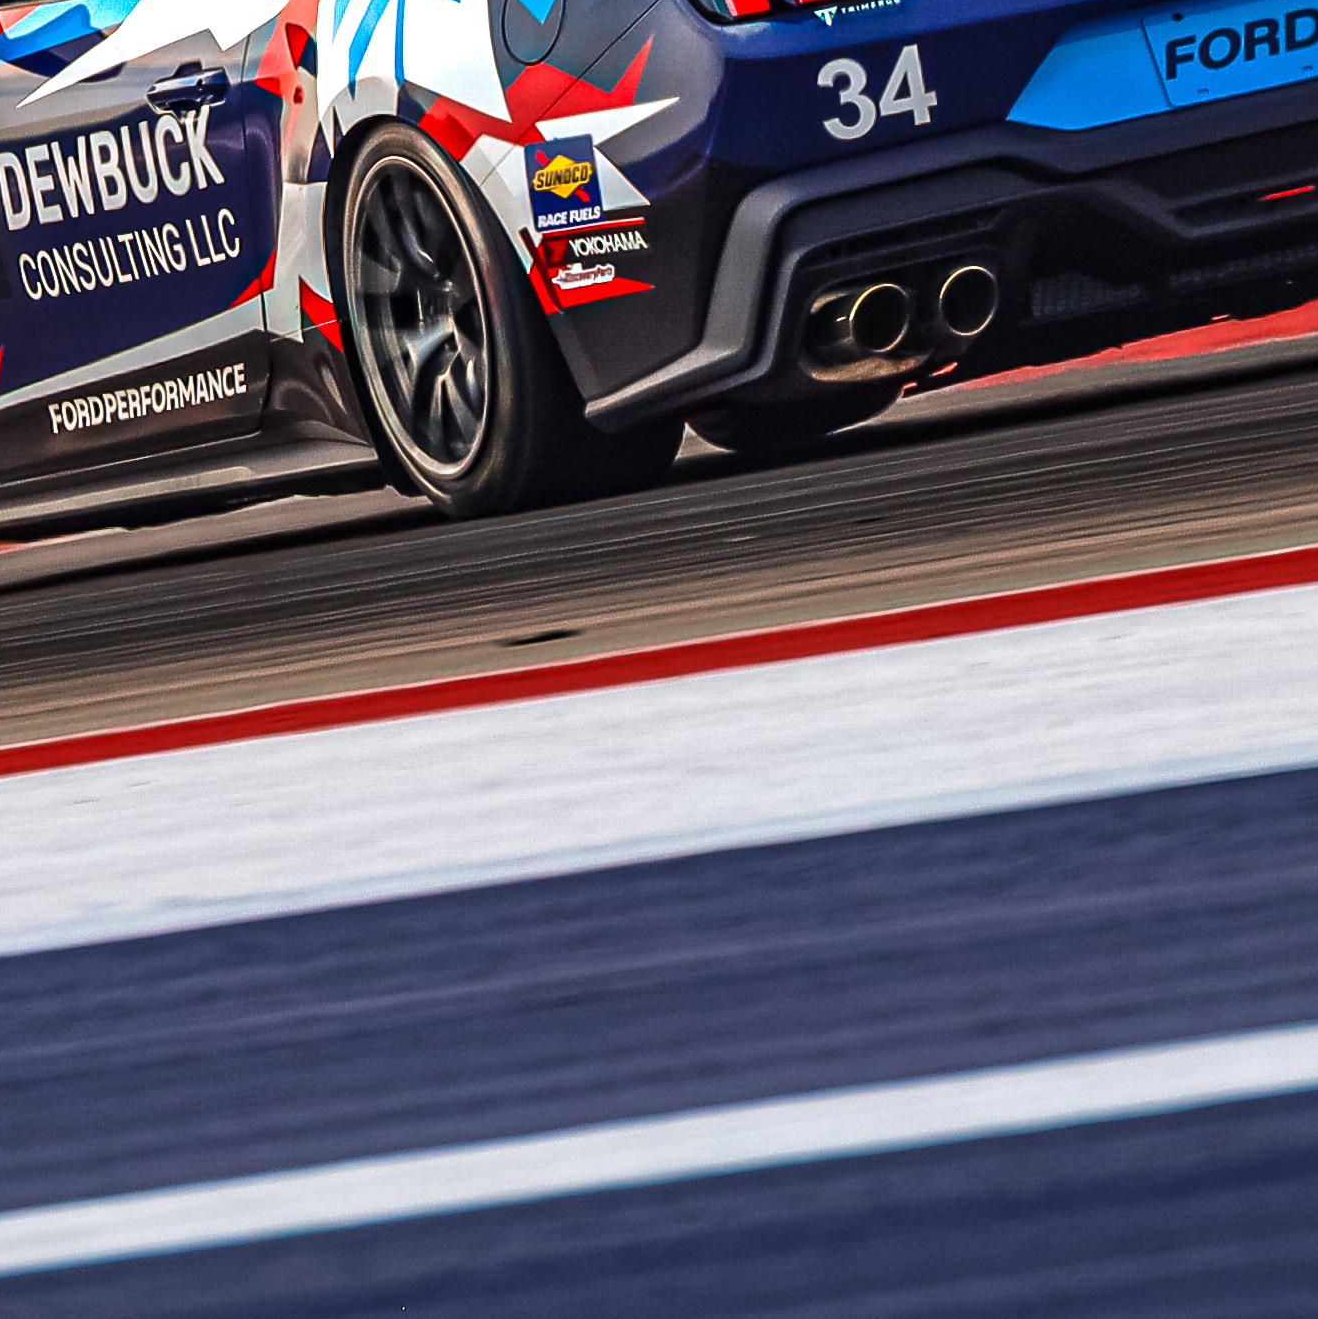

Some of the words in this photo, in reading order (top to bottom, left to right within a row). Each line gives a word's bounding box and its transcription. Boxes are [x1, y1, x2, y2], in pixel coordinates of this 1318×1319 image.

[817, 44, 938, 140] 34
[536, 164, 590, 189] SUNOCO
[537, 211, 568, 229] RACE
[569, 206, 602, 223] FUELS
[18, 222, 187, 300] CONSULTING
[185, 208, 241, 267] LLC
[569, 230, 648, 257] YOKOHAMA
